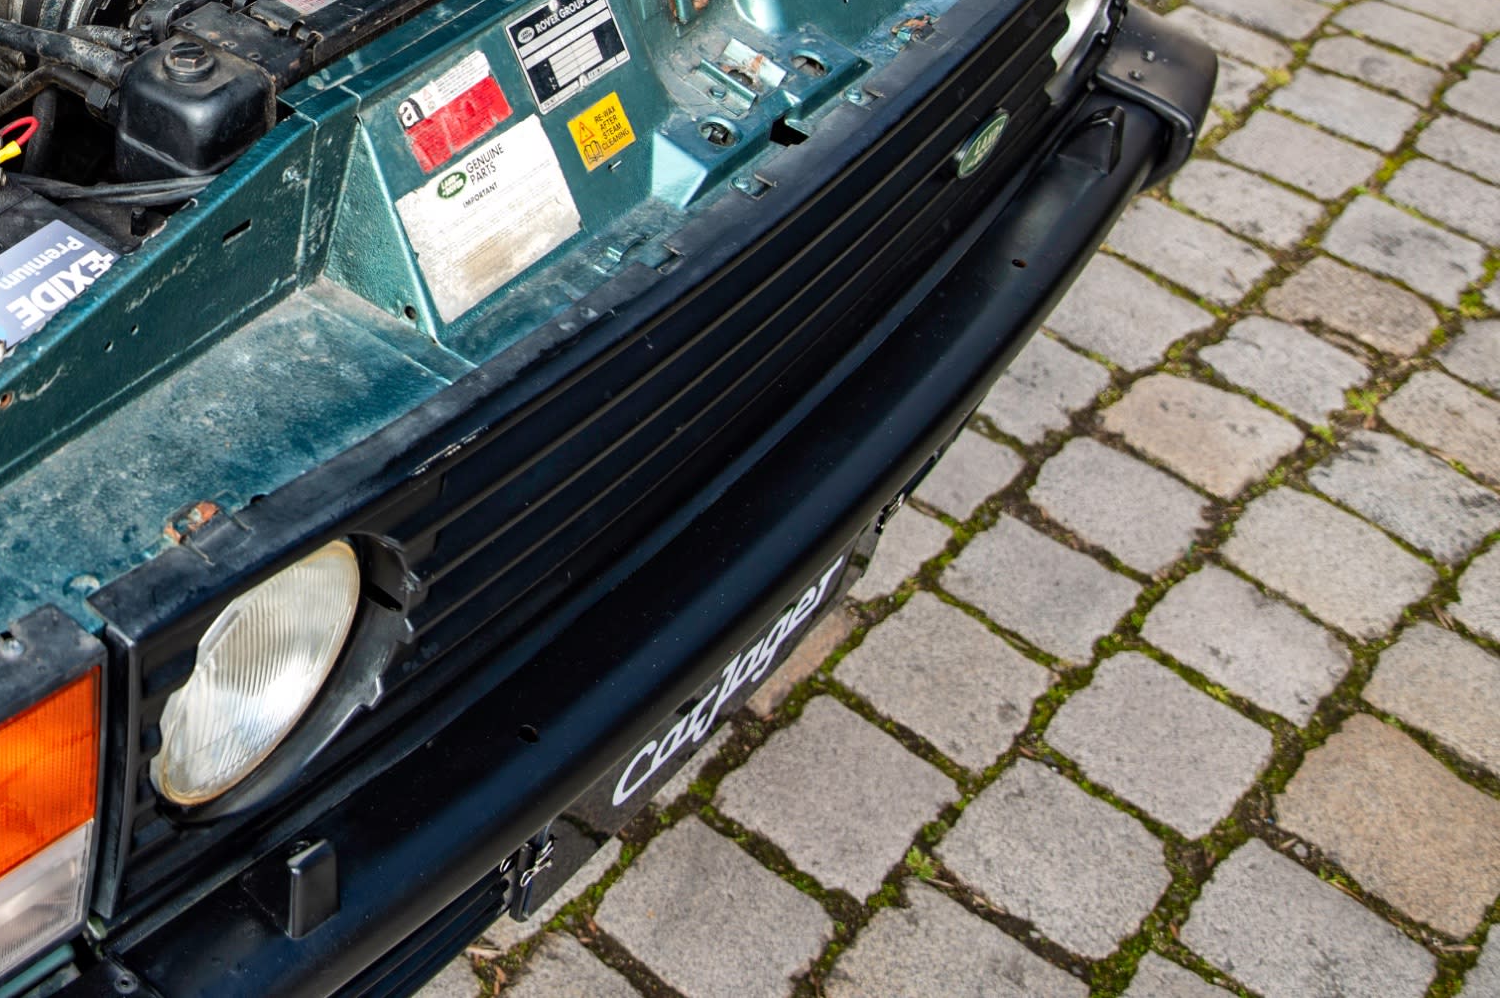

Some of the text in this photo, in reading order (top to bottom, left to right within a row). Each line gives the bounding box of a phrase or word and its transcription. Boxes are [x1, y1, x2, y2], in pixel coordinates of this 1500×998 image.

[534, 13, 560, 34] ROVER
[399, 101, 420, 127] a
[592, 105, 616, 123] RE-WAX
[599, 113, 618, 130] AFTER
[600, 127, 630, 150] CLEANING
[602, 122, 622, 139] STEAM
[465, 143, 504, 174] GENUINE
[469, 161, 497, 185] PARTS
[462, 181, 498, 208] IMPORTANT
[4, 248, 114, 328] EXIDE
[612, 555, 844, 806] CarJager
